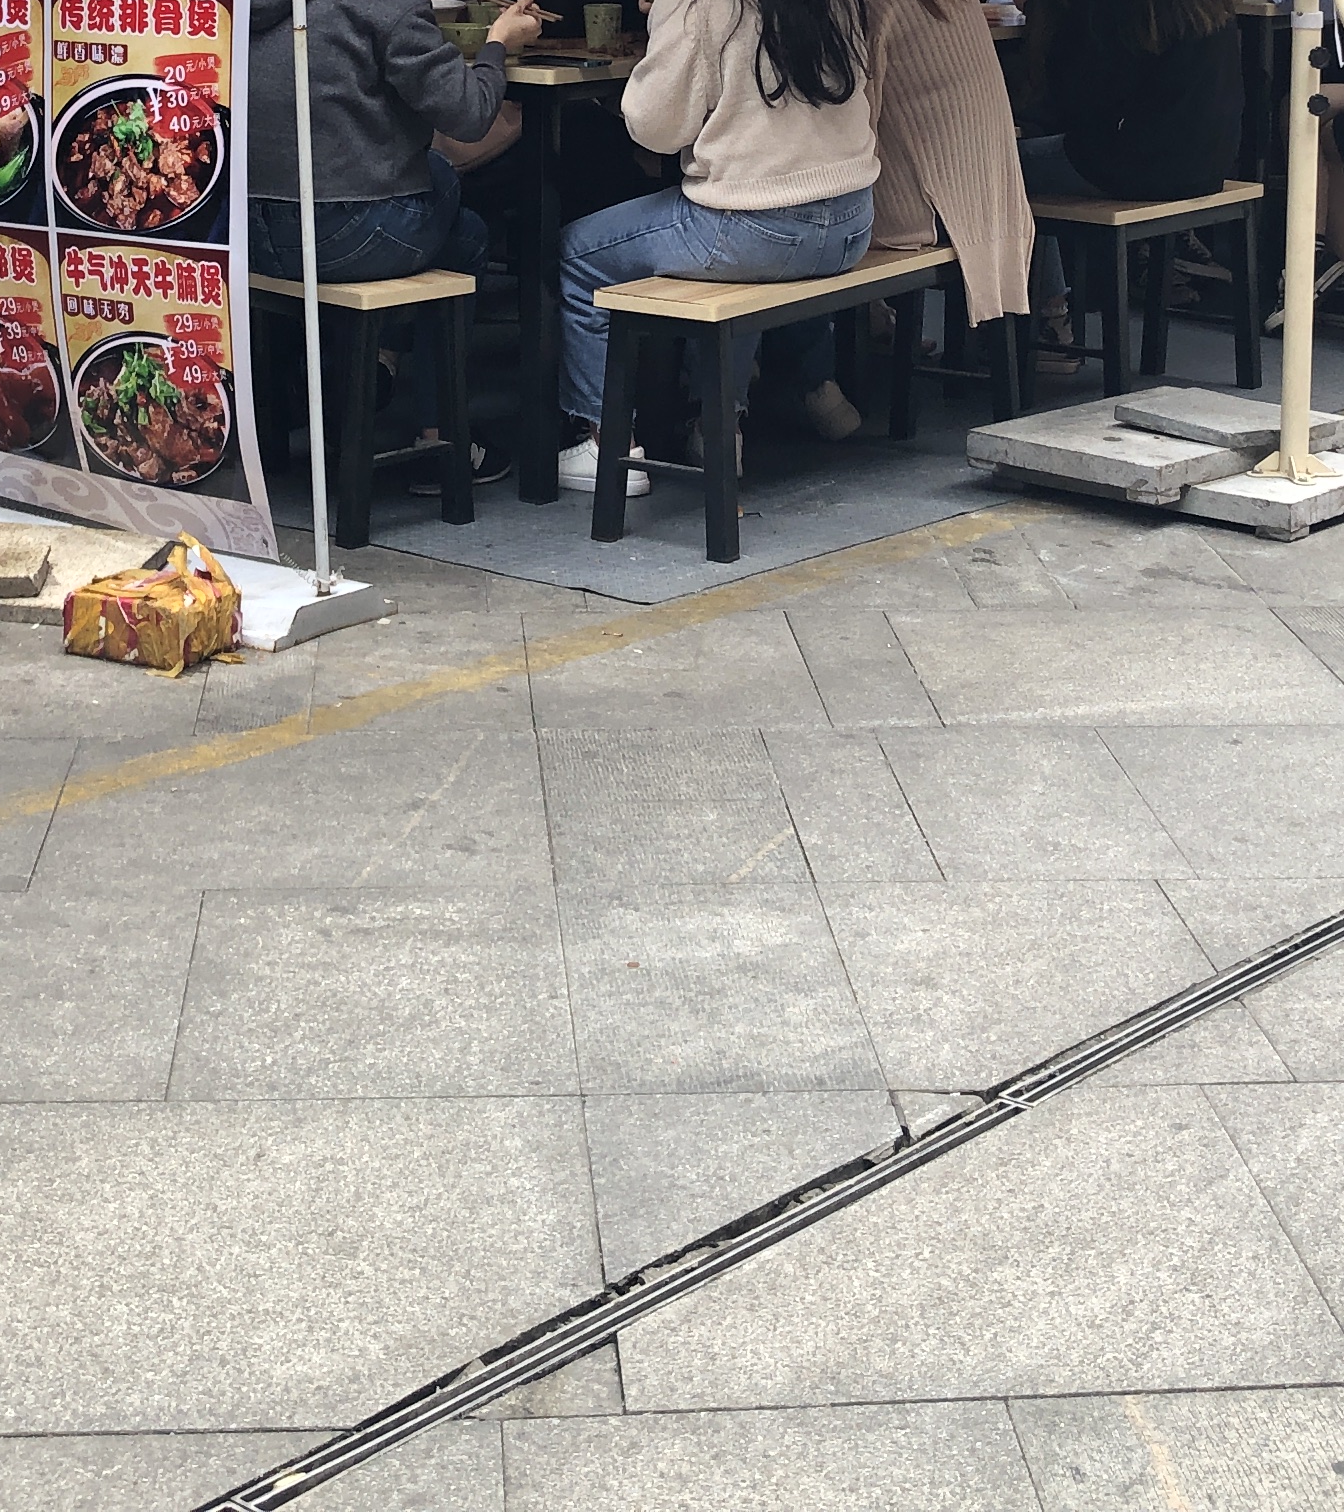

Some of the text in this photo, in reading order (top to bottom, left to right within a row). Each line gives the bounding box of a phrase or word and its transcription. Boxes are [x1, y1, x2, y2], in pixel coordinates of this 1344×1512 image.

[66, 248, 223, 307] 牛气冲天牛腩煲
[66, 297, 130, 321] 回味无穷
